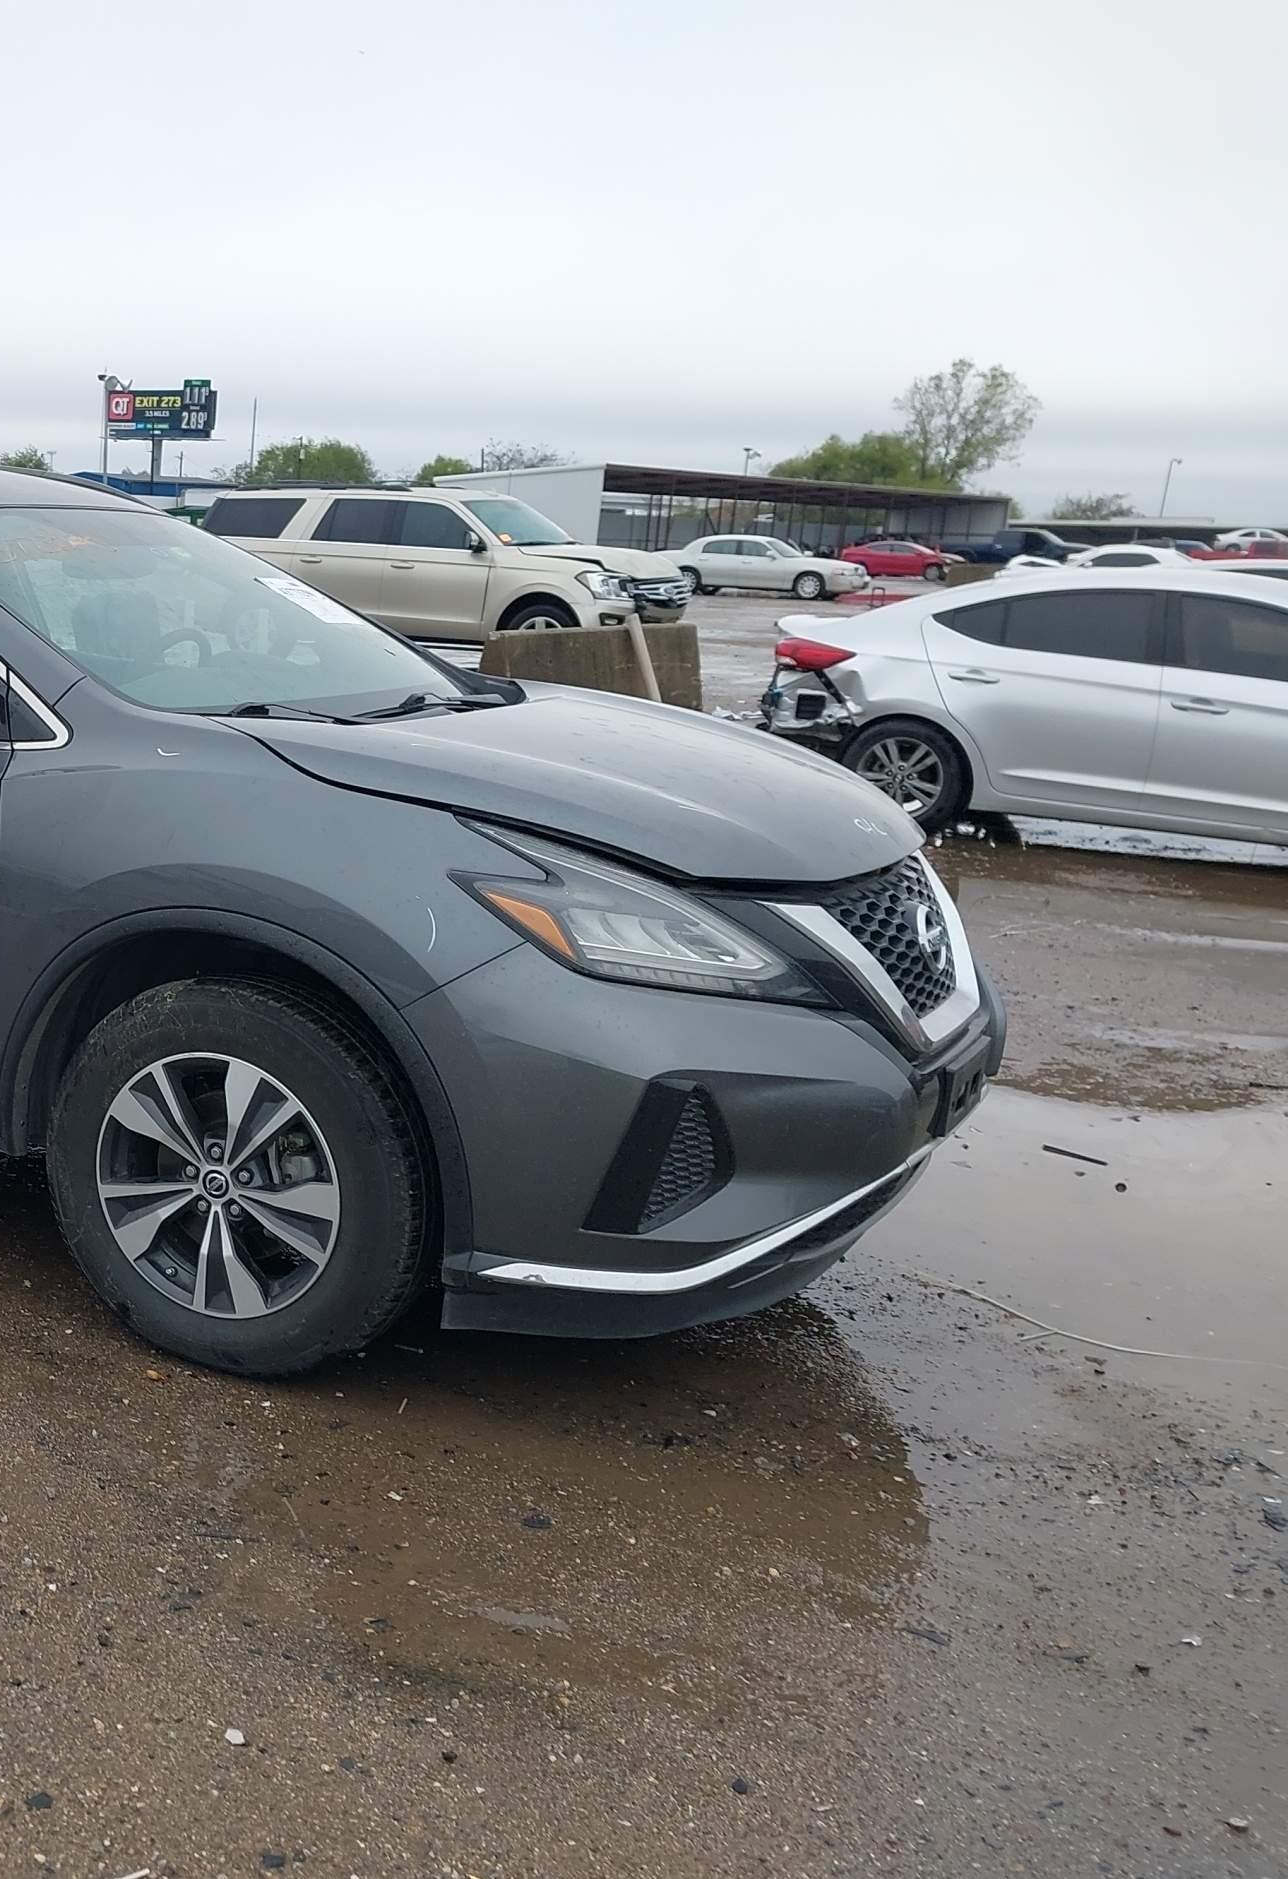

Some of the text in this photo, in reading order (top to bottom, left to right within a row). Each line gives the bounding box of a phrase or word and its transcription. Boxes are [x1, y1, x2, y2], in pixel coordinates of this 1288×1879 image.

[112, 397, 129, 416] QT
[135, 396, 159, 408] EXIT
[161, 396, 182, 408] 273
